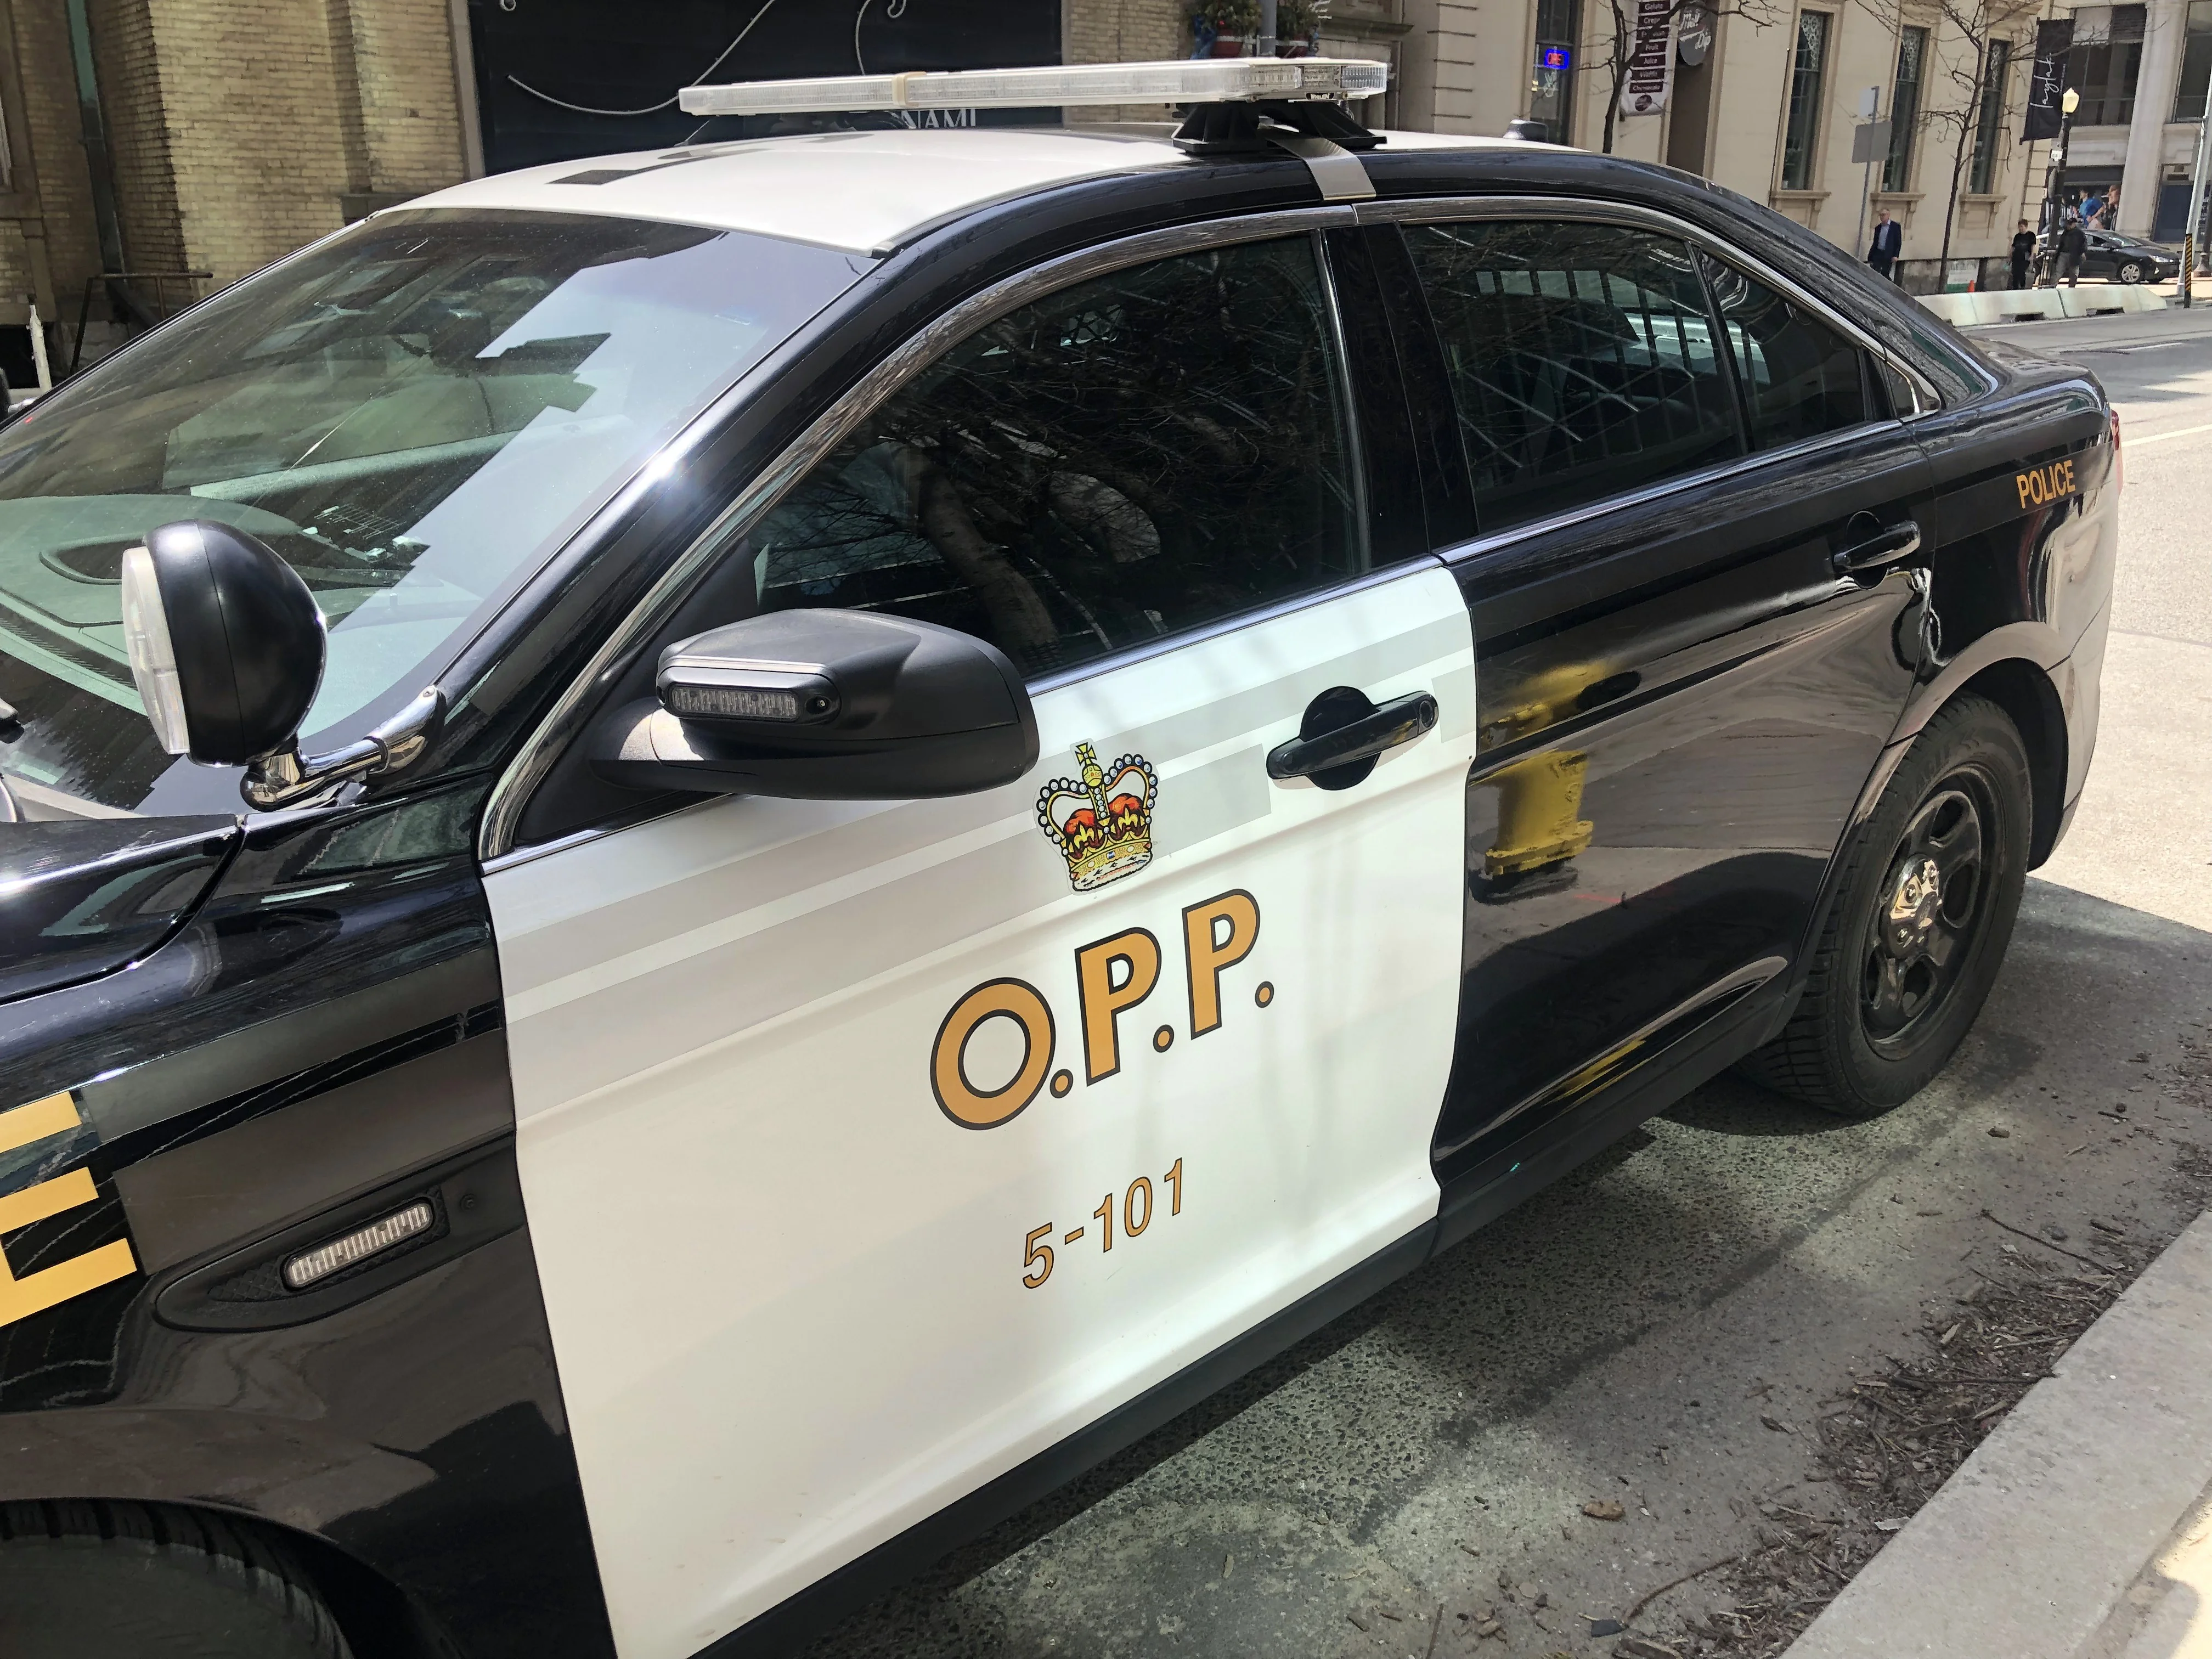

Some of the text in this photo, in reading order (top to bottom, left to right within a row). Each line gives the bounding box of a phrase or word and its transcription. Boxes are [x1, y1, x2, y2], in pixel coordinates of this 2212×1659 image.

[901, 109, 976, 129] NAMI
[2016, 460, 2075, 509] POLICE
[930, 888, 1274, 1130] O.P.P.
[1022, 1158, 1183, 1289] 5-101
